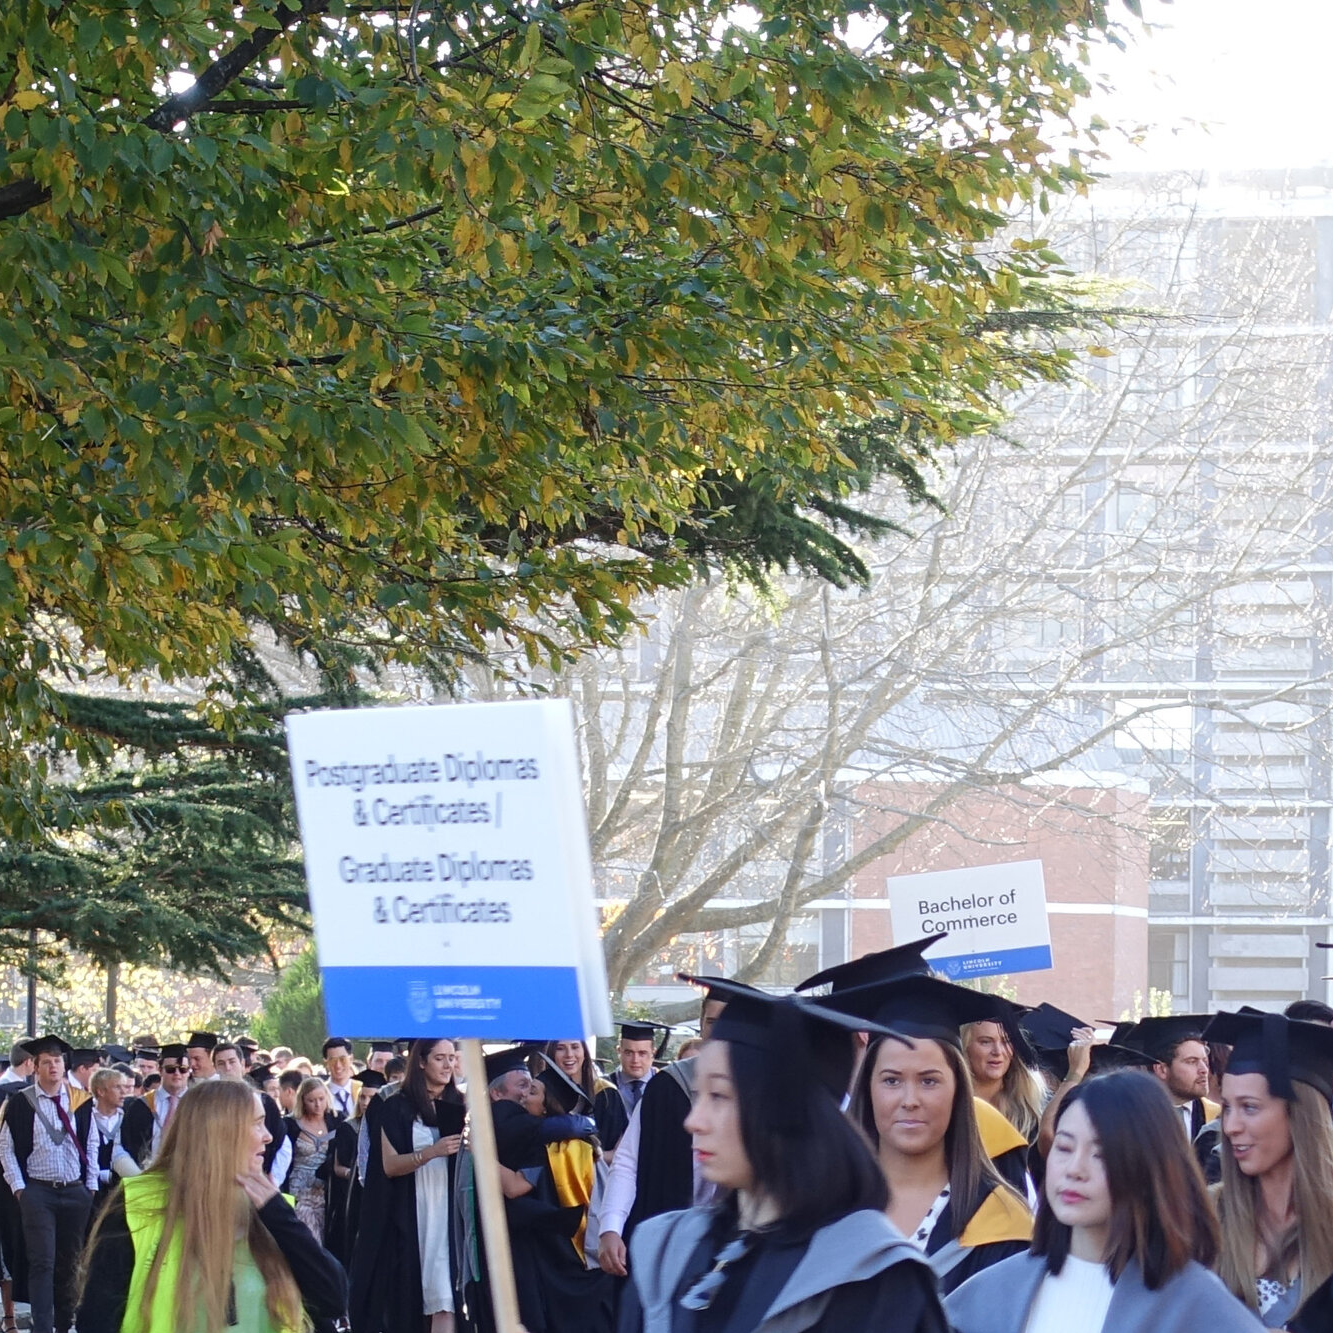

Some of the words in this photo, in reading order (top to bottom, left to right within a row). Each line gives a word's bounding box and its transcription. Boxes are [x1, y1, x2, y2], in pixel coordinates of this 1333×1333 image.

[305, 754, 441, 793] Postgraduate
[443, 750, 540, 789] Diplomas
[353, 798, 369, 827] &
[372, 794, 493, 833] Certificates
[338, 853, 436, 884] Graduate
[437, 850, 535, 889] Diplomas
[373, 896, 389, 924] &
[392, 894, 512, 925] Certificates
[918, 894, 994, 914] Bachelor
[999, 889, 1016, 905] of
[922, 912, 1017, 933] Commerce
